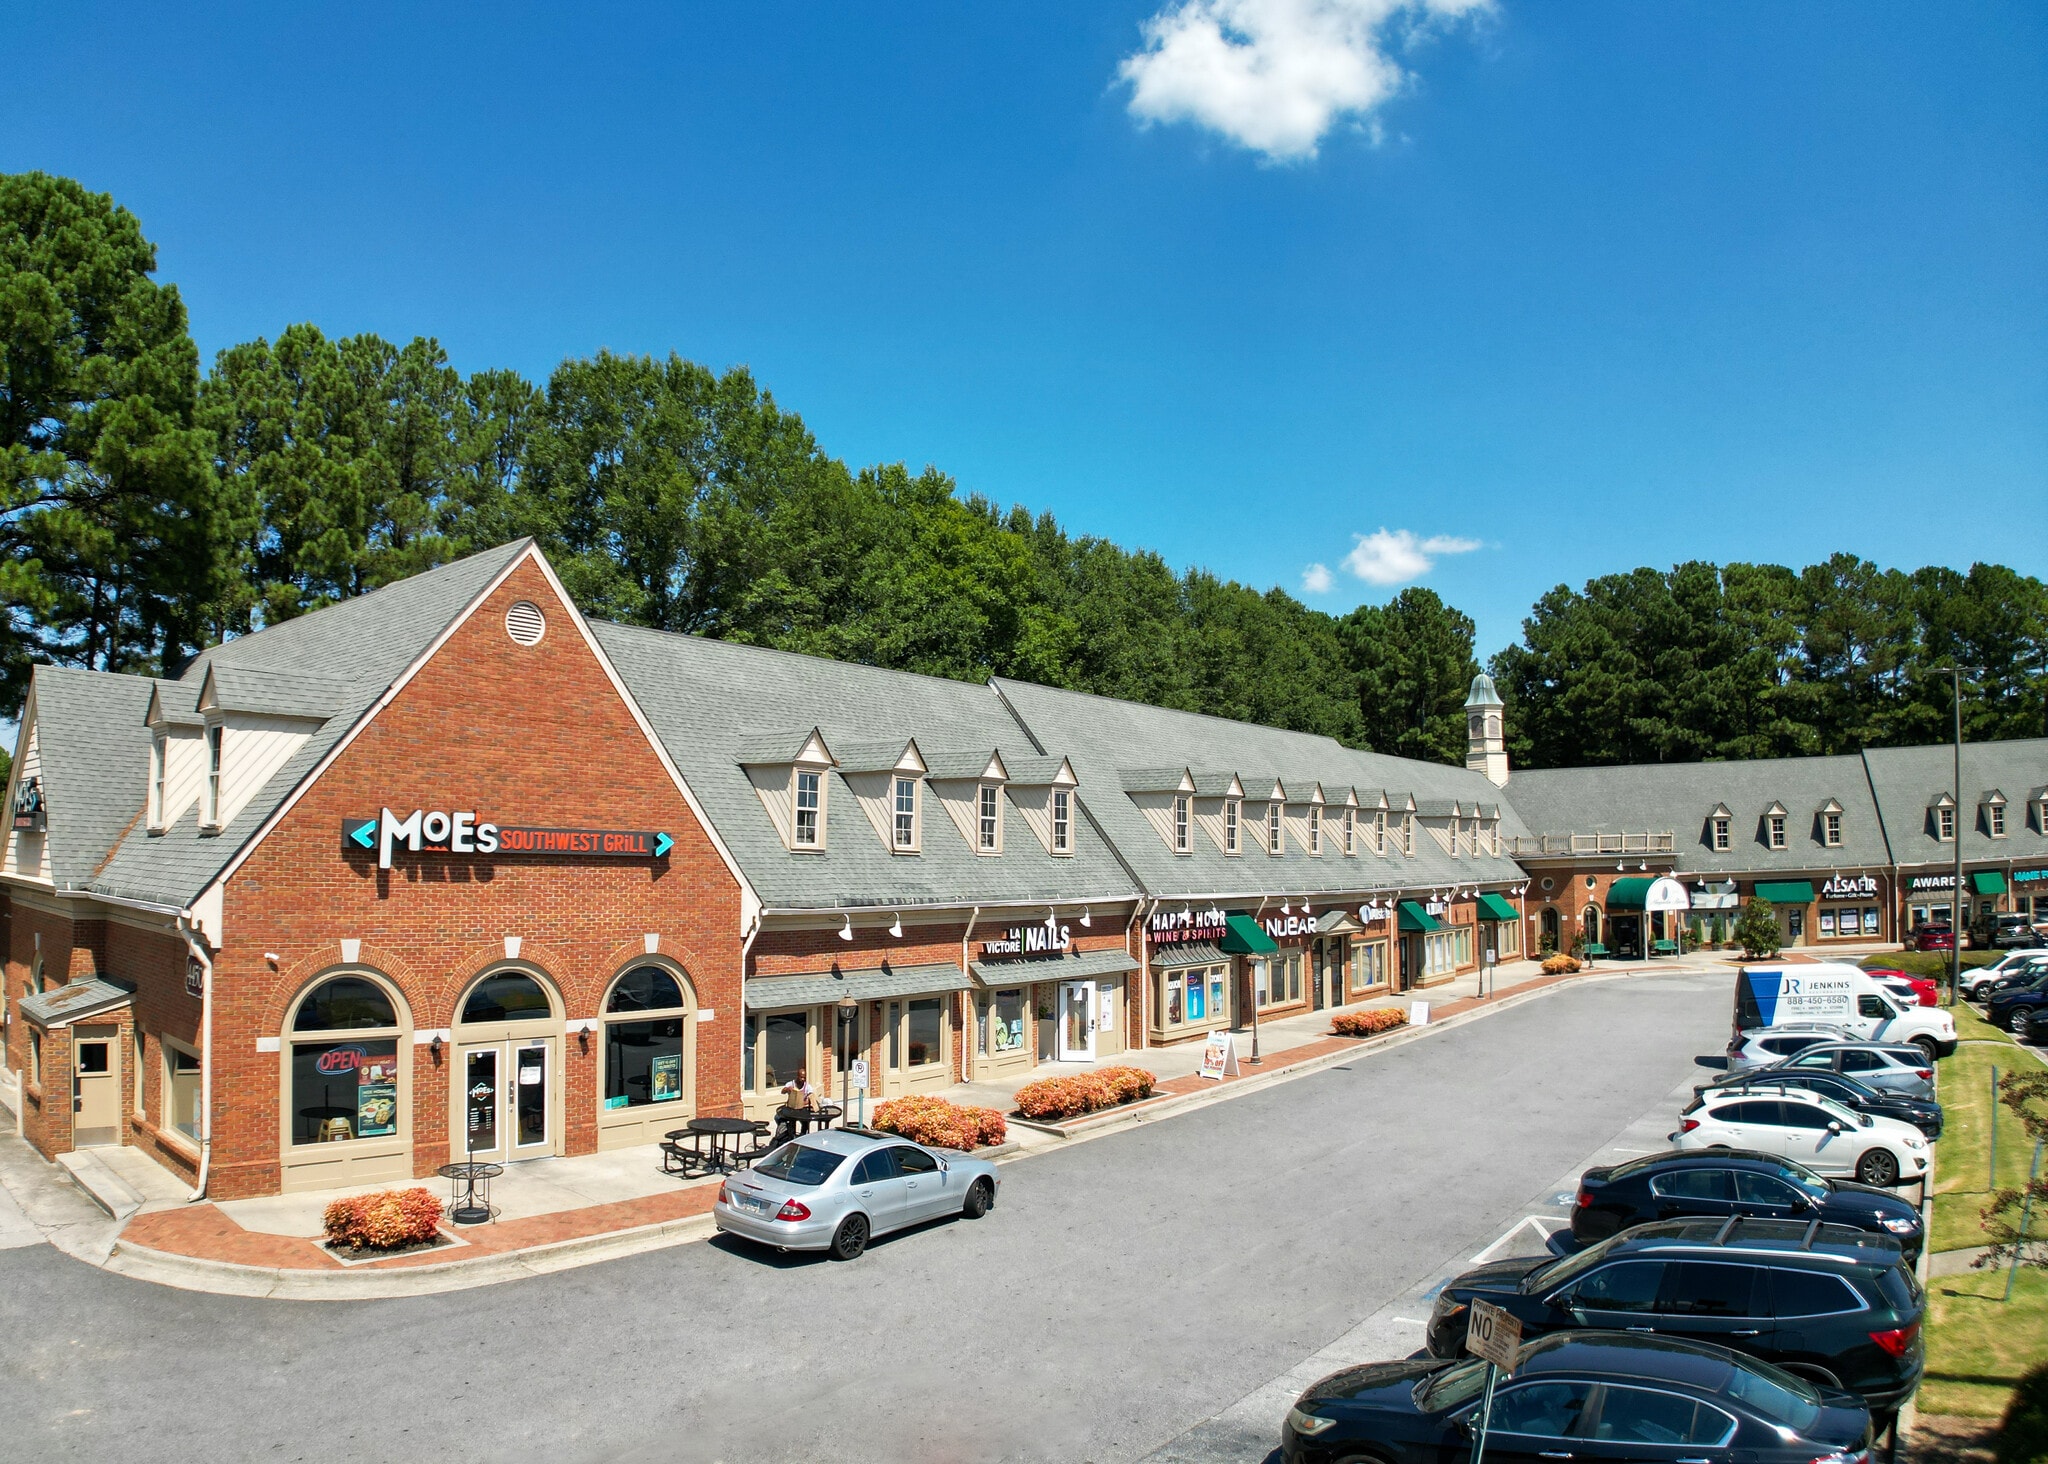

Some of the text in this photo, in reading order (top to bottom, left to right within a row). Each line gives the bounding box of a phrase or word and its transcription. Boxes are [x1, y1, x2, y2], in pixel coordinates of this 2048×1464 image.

[500, 829, 601, 852] SOUTHWEST
[1822, 878, 1878, 893] ALSAFIR
[1912, 876, 1966, 888] AWARDS
[1152, 910, 1226, 930] HAPPY HOUR
[1009, 928, 1021, 940] LA
[1025, 925, 1070, 952] NAILS
[1154, 931, 1178, 943] WINE
[1192, 927, 1226, 940] SPIRITS
[1809, 981, 1850, 990] JENKINS
[320, 1051, 361, 1070] OPEN
[1473, 1299, 1521, 1328] PRIVATE PROPERTY
[1471, 1311, 1492, 1342] NO
